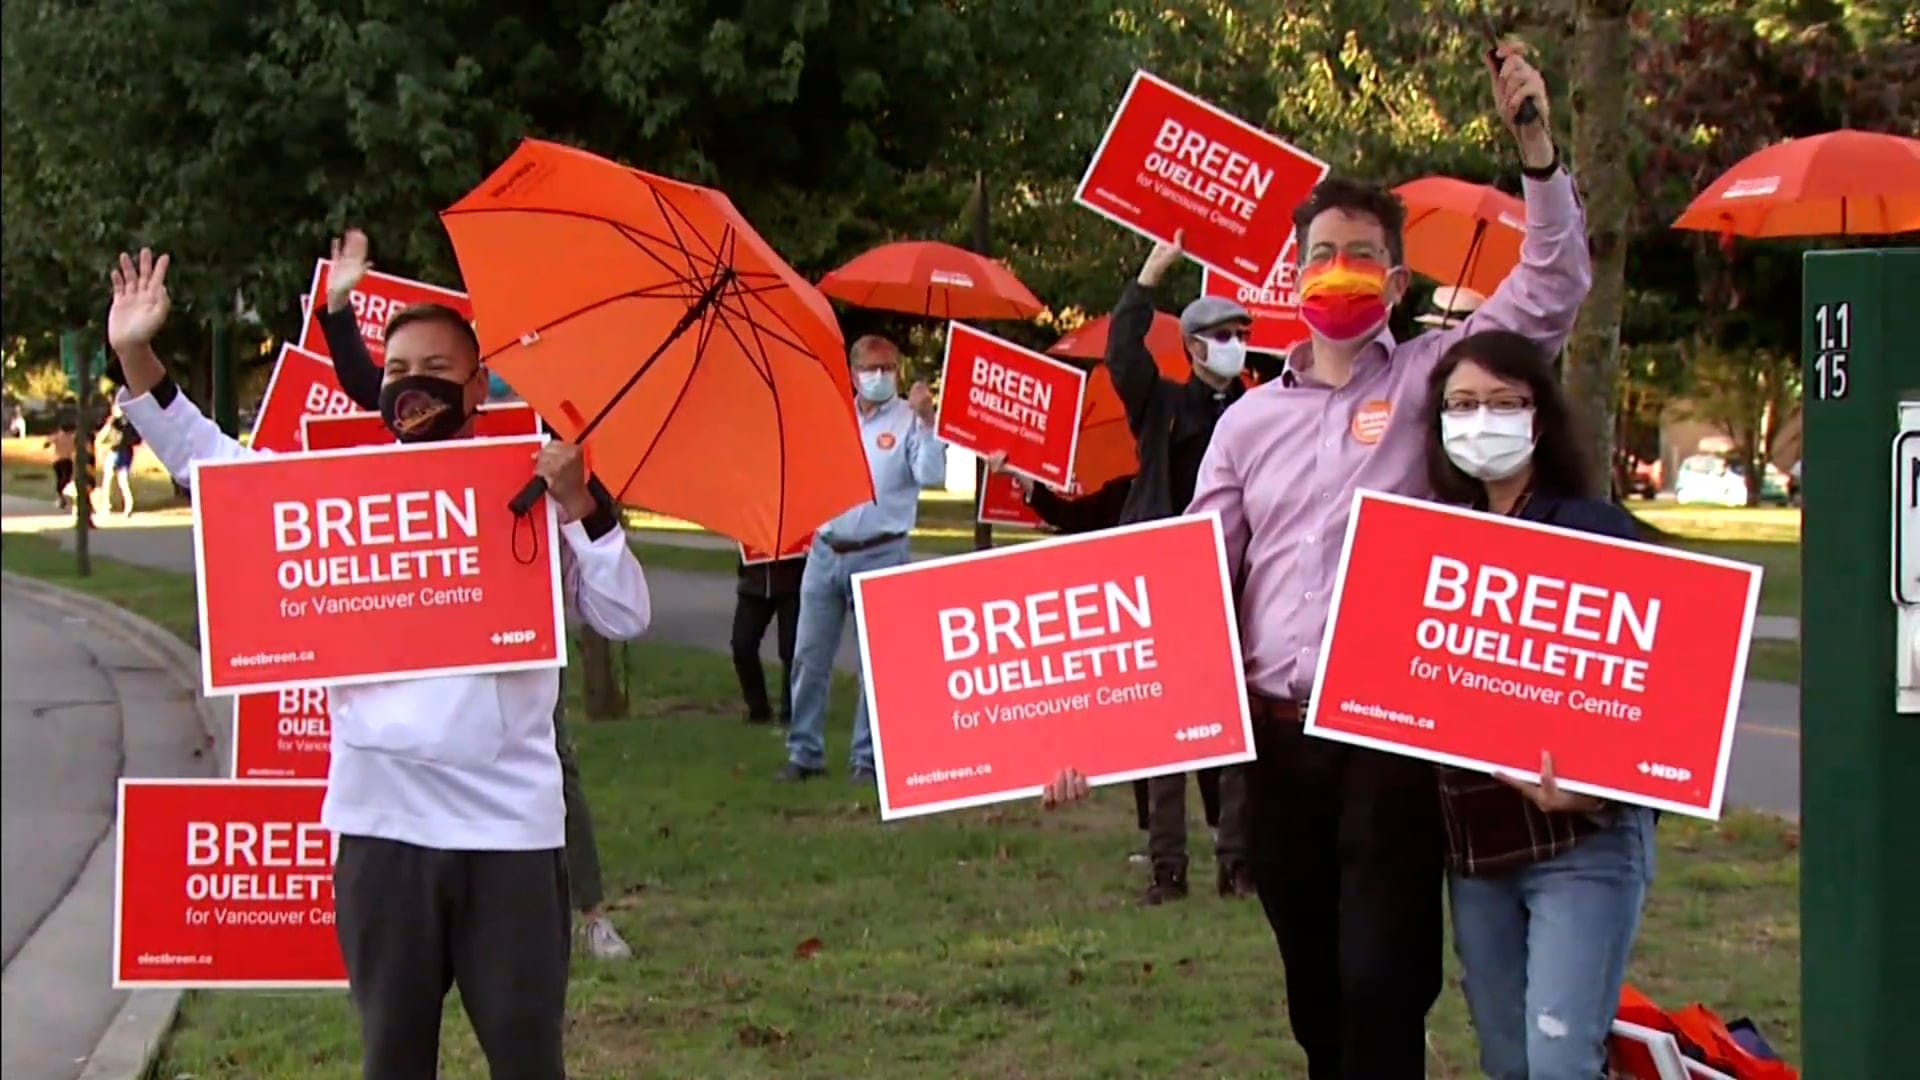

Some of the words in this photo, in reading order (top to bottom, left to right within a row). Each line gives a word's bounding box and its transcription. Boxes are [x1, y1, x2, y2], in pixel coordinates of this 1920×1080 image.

[1154, 118, 1274, 200] BREEN
[1144, 153, 1258, 220] OUELLETTE
[1815, 302, 1851, 350] 1.1
[972, 356, 1052, 411] BREEN
[1815, 354, 1847, 400] 15
[969, 386, 1048, 432] OUELLETTE
[272, 487, 479, 553] BREEN
[277, 546, 480, 590] OUELLETTE
[279, 598, 309, 617] for
[312, 591, 415, 615] Vancouver
[419, 584, 484, 605] Centre
[938, 575, 1153, 662] BREEN
[1421, 555, 1661, 652] BREEN
[230, 650, 315, 668] electbreen.ca
[503, 631, 536, 645] NDP
[1415, 618, 1649, 693] OUELLETTE
[946, 638, 1158, 700] OUELLETTE
[1409, 656, 1442, 682] for
[1445, 663, 1564, 706] Vancouver
[1567, 690, 1643, 722] Centre
[952, 709, 980, 730] for
[983, 693, 1091, 724] Vancouver
[1095, 679, 1163, 706] Centre
[1340, 699, 1436, 731] electbreen.ca
[1186, 722, 1223, 742] NDP
[905, 762, 992, 788] electbreen.ca
[1651, 763, 1692, 782] NDP
[186, 821, 341, 867] BREE
[186, 907, 209, 924] for
[214, 908, 304, 925] Vancouver
